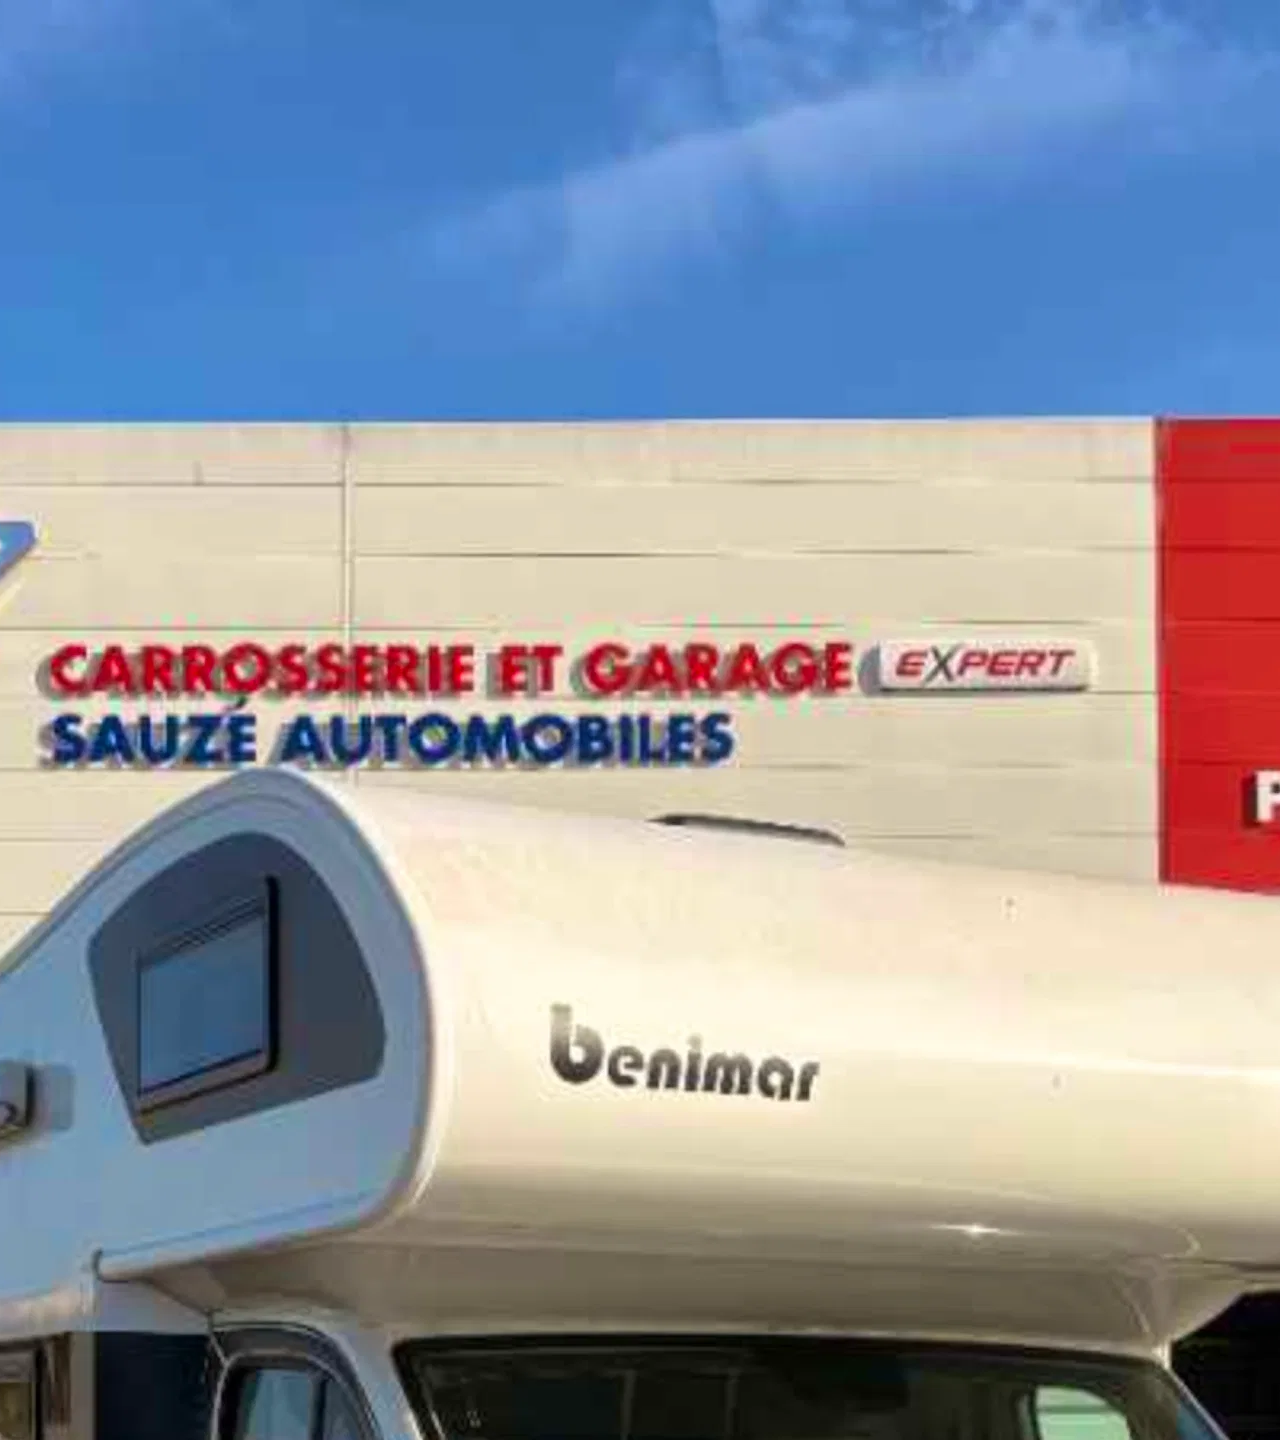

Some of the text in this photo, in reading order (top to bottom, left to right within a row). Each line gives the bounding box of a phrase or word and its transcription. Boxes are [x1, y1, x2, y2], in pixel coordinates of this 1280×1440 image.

[49, 642, 855, 693] CARROSSERIE ET GARAGE
[279, 712, 736, 764] AUTOMOBILES
[549, 1002, 821, 1102] benimar
